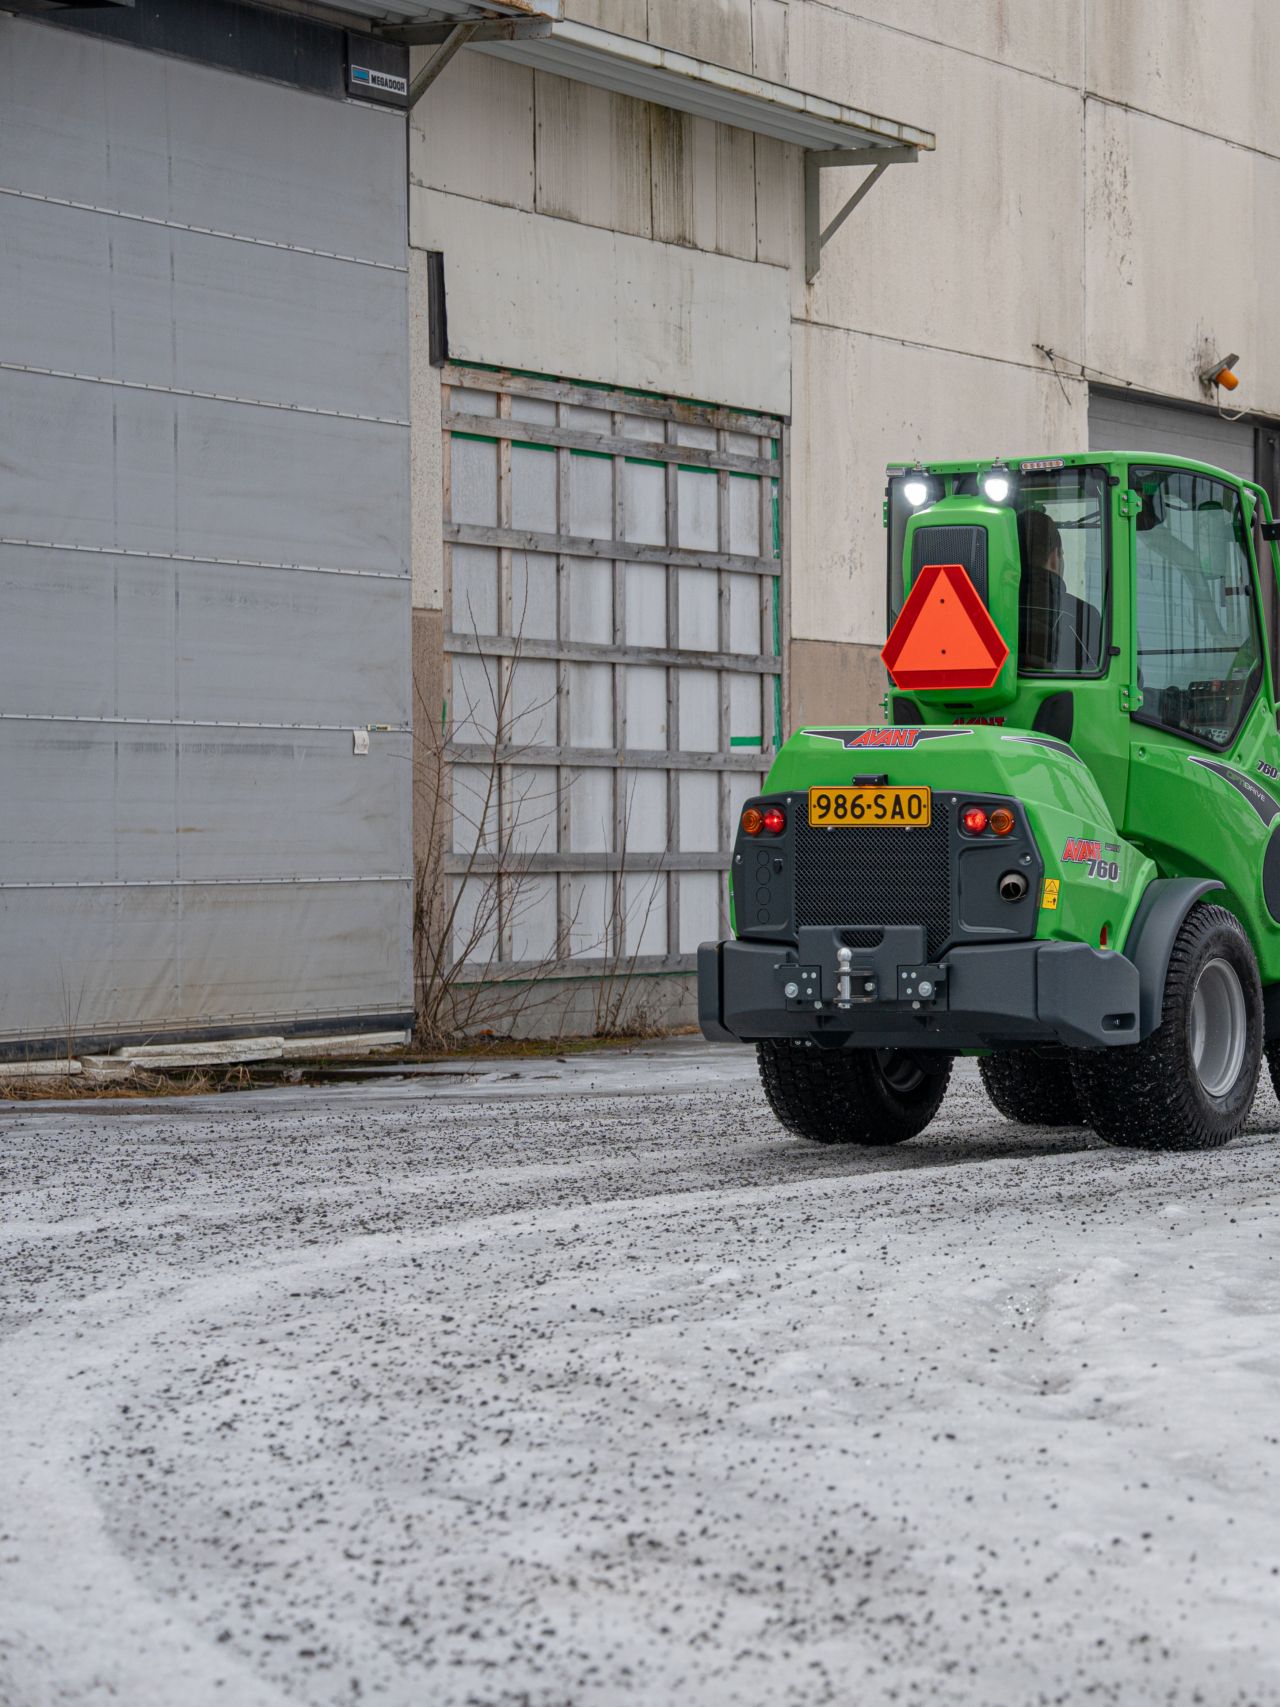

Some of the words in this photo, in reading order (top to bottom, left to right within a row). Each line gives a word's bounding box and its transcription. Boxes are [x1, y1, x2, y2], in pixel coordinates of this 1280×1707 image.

[371, 74, 405, 93] MEGADOOR
[847, 728, 920, 747] AVANT
[1061, 837, 1101, 864] AVANT
